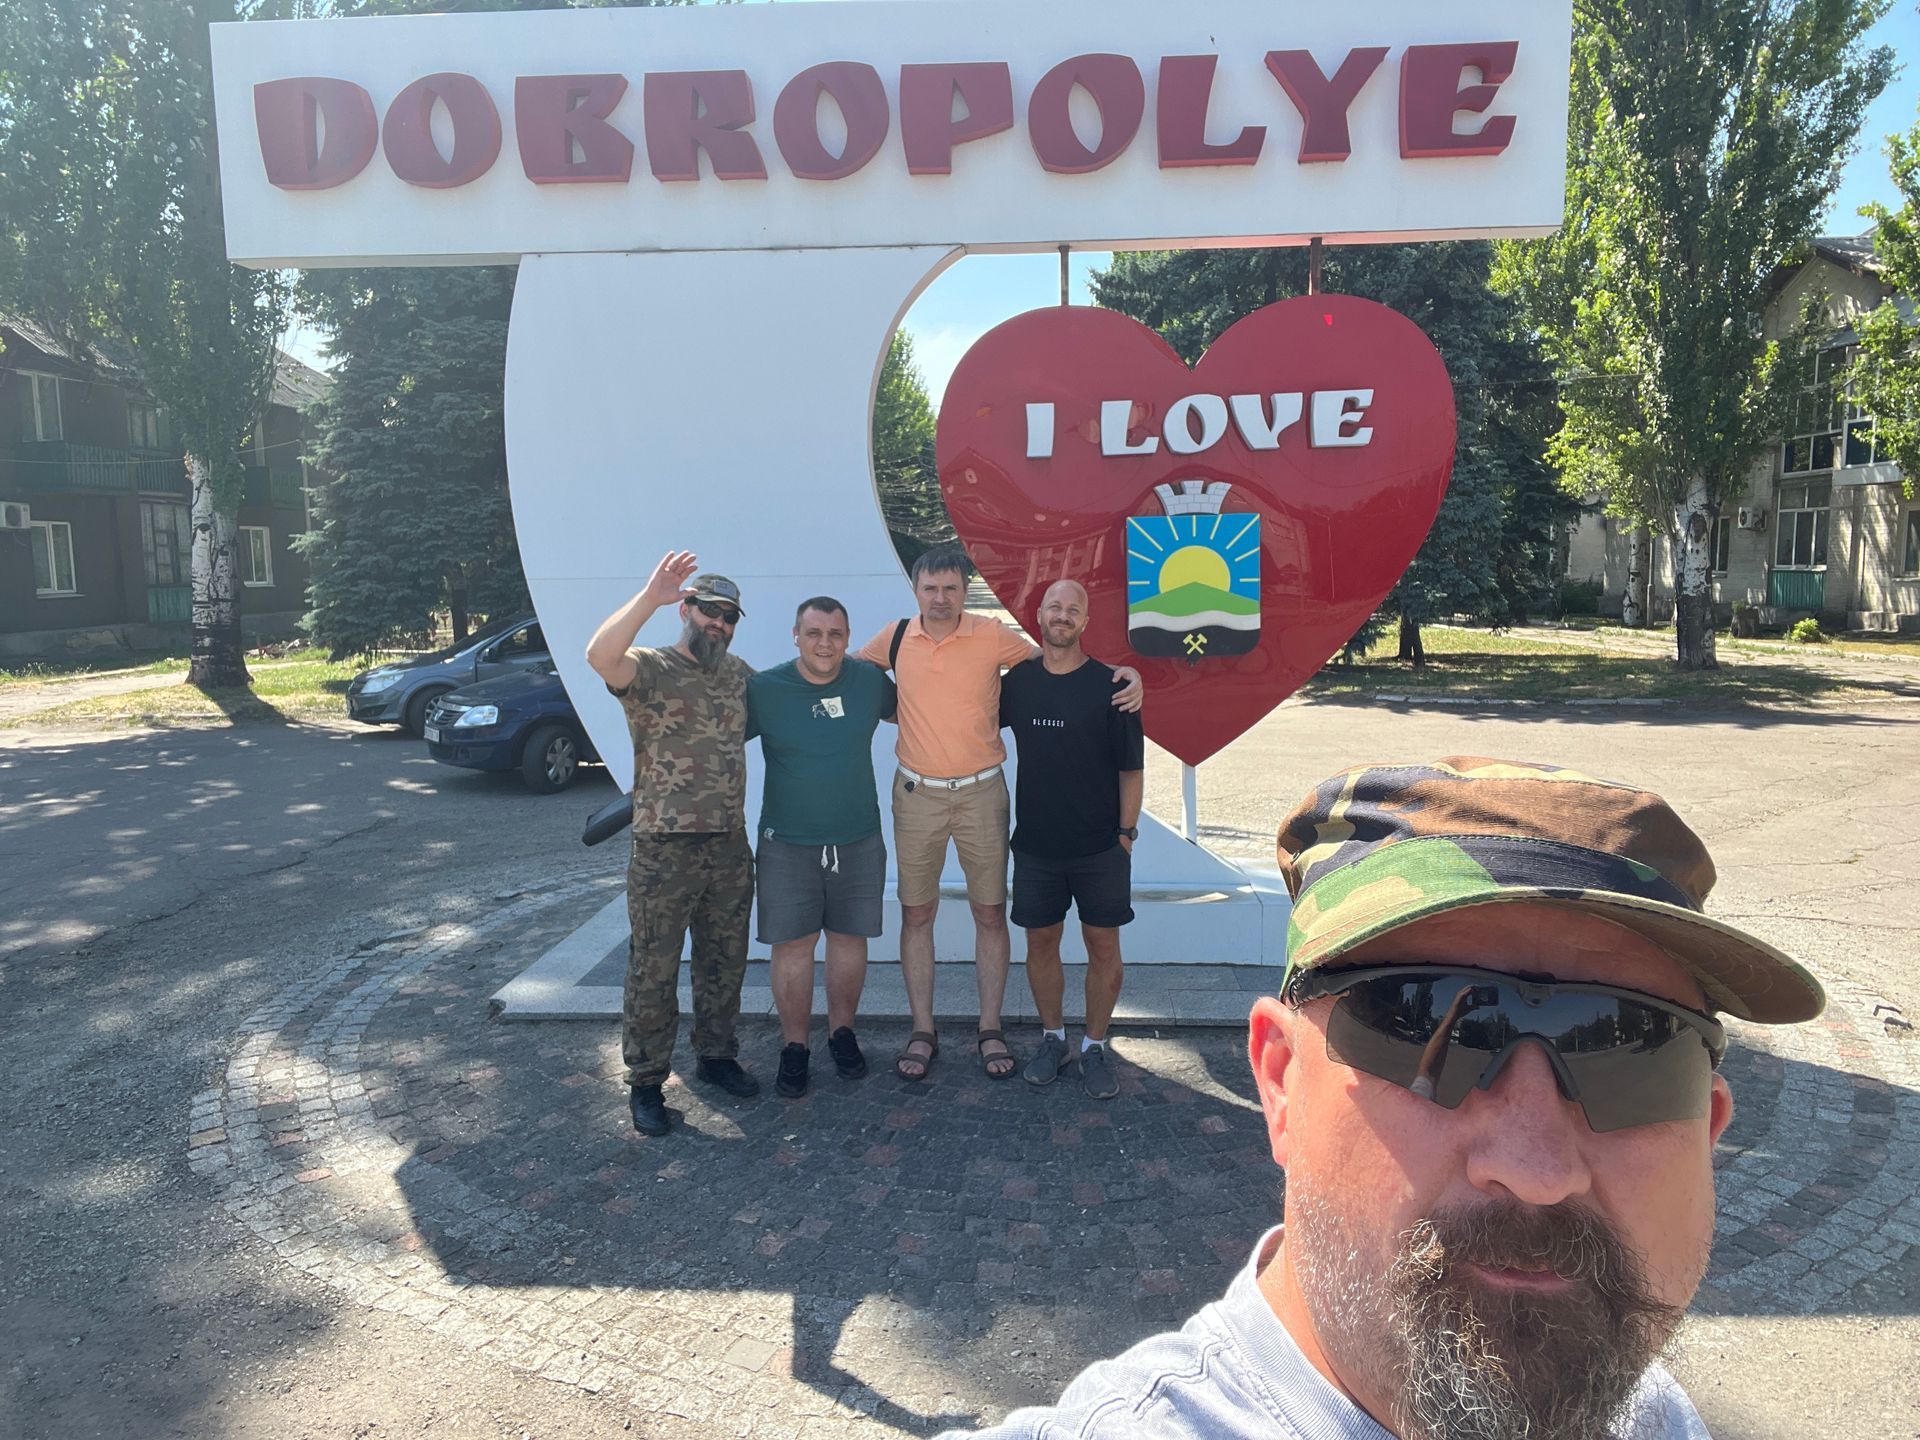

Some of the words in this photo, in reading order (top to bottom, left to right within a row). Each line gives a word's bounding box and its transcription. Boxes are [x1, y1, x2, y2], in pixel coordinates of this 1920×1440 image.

[253, 41, 1519, 191] DOBROPOLYE
[1025, 402, 1055, 458] I
[1100, 389, 1375, 456] LOVE
